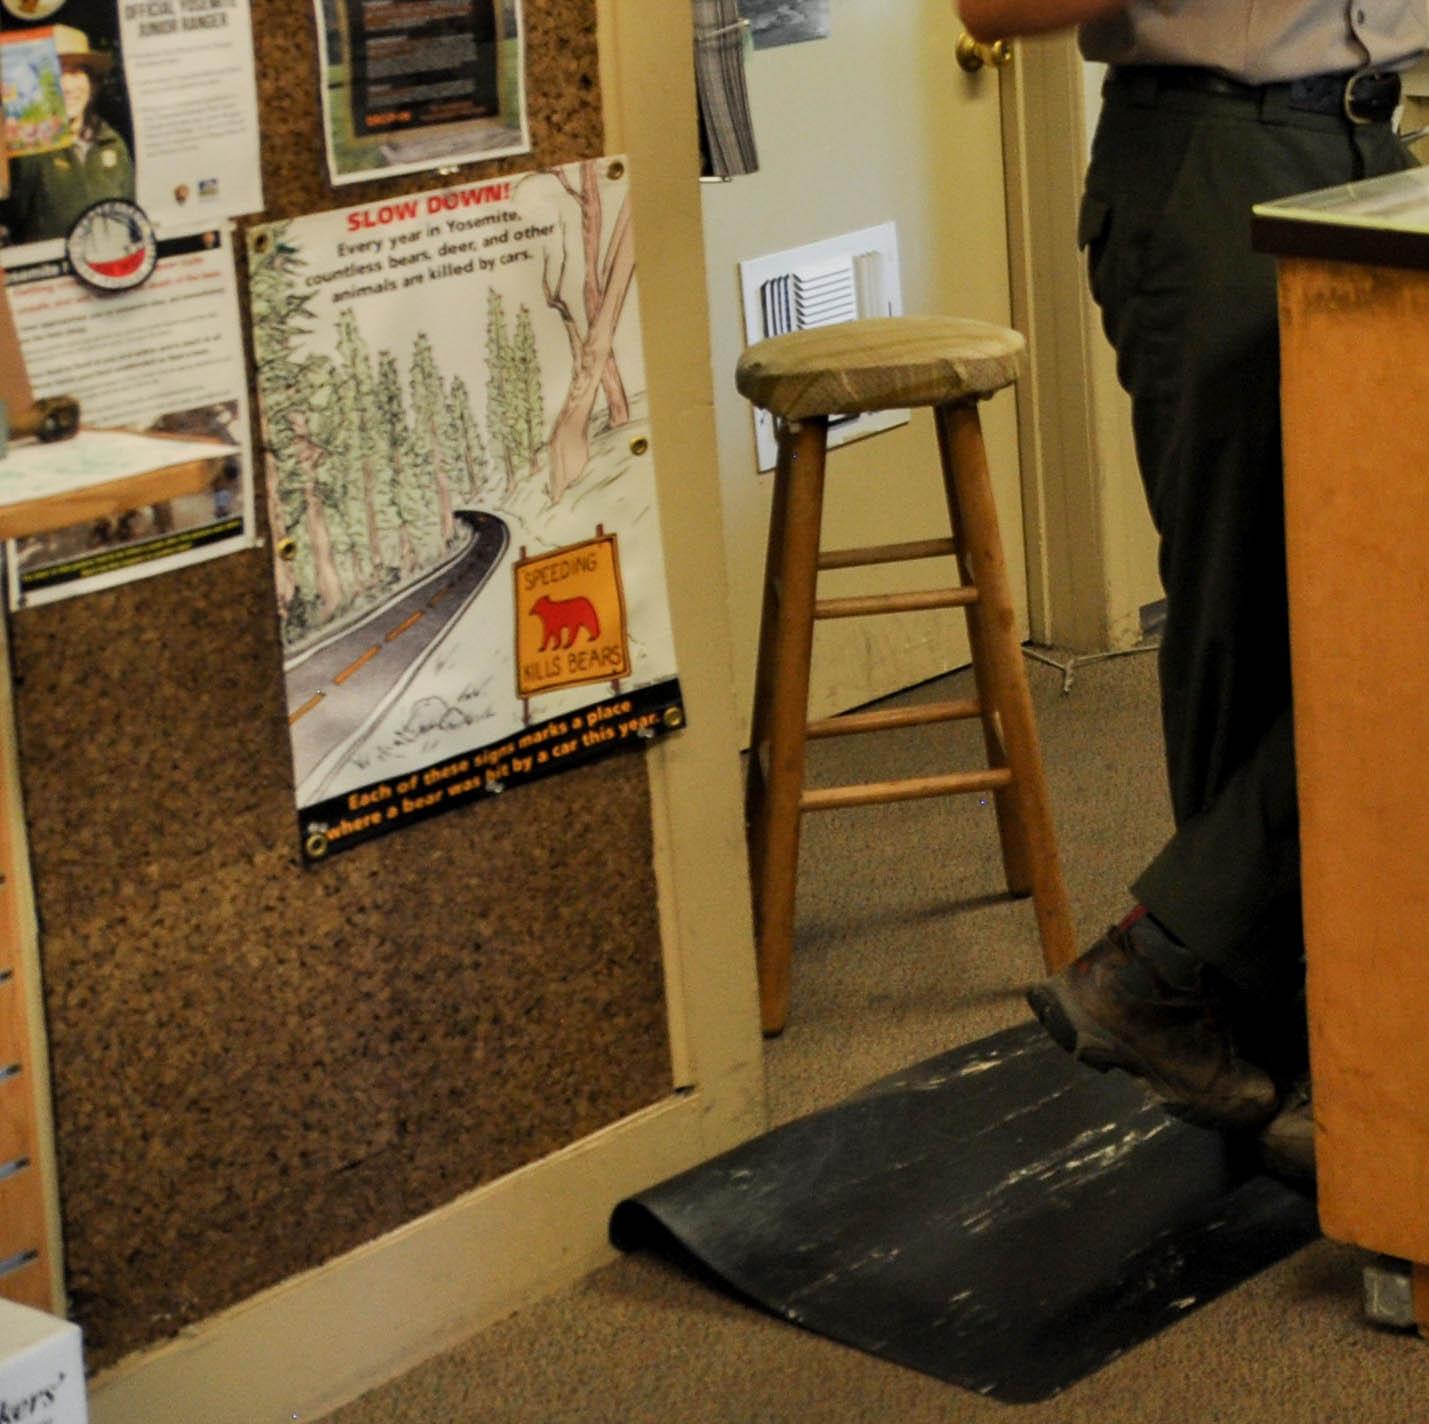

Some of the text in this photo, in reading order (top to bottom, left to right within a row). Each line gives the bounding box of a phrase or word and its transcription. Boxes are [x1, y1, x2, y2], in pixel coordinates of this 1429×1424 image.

[347, 182, 511, 232] SLOW DOWN!
[304, 261, 382, 288] countless
[482, 231, 509, 248] and
[514, 222, 556, 242] other
[336, 238, 383, 258] Every
[389, 230, 422, 250] year
[426, 223, 441, 238] in
[331, 277, 398, 303] animals
[402, 273, 425, 288] are
[428, 258, 474, 279] killed
[478, 256, 496, 272] by
[524, 552, 598, 591] SPEEDING
[523, 645, 621, 681] KILLS BEARS
[325, 811, 382, 842] where
[402, 787, 443, 814] bear
[448, 776, 482, 798] was
[512, 754, 533, 775] by
[552, 741, 578, 760] car
[581, 725, 616, 748] this
[618, 714, 660, 741] year.
[348, 785, 392, 812] Each
[396, 773, 420, 794] of
[423, 760, 470, 786] these
[473, 740, 516, 769] signs
[518, 721, 568, 747] marks
[586, 699, 633, 728] place
